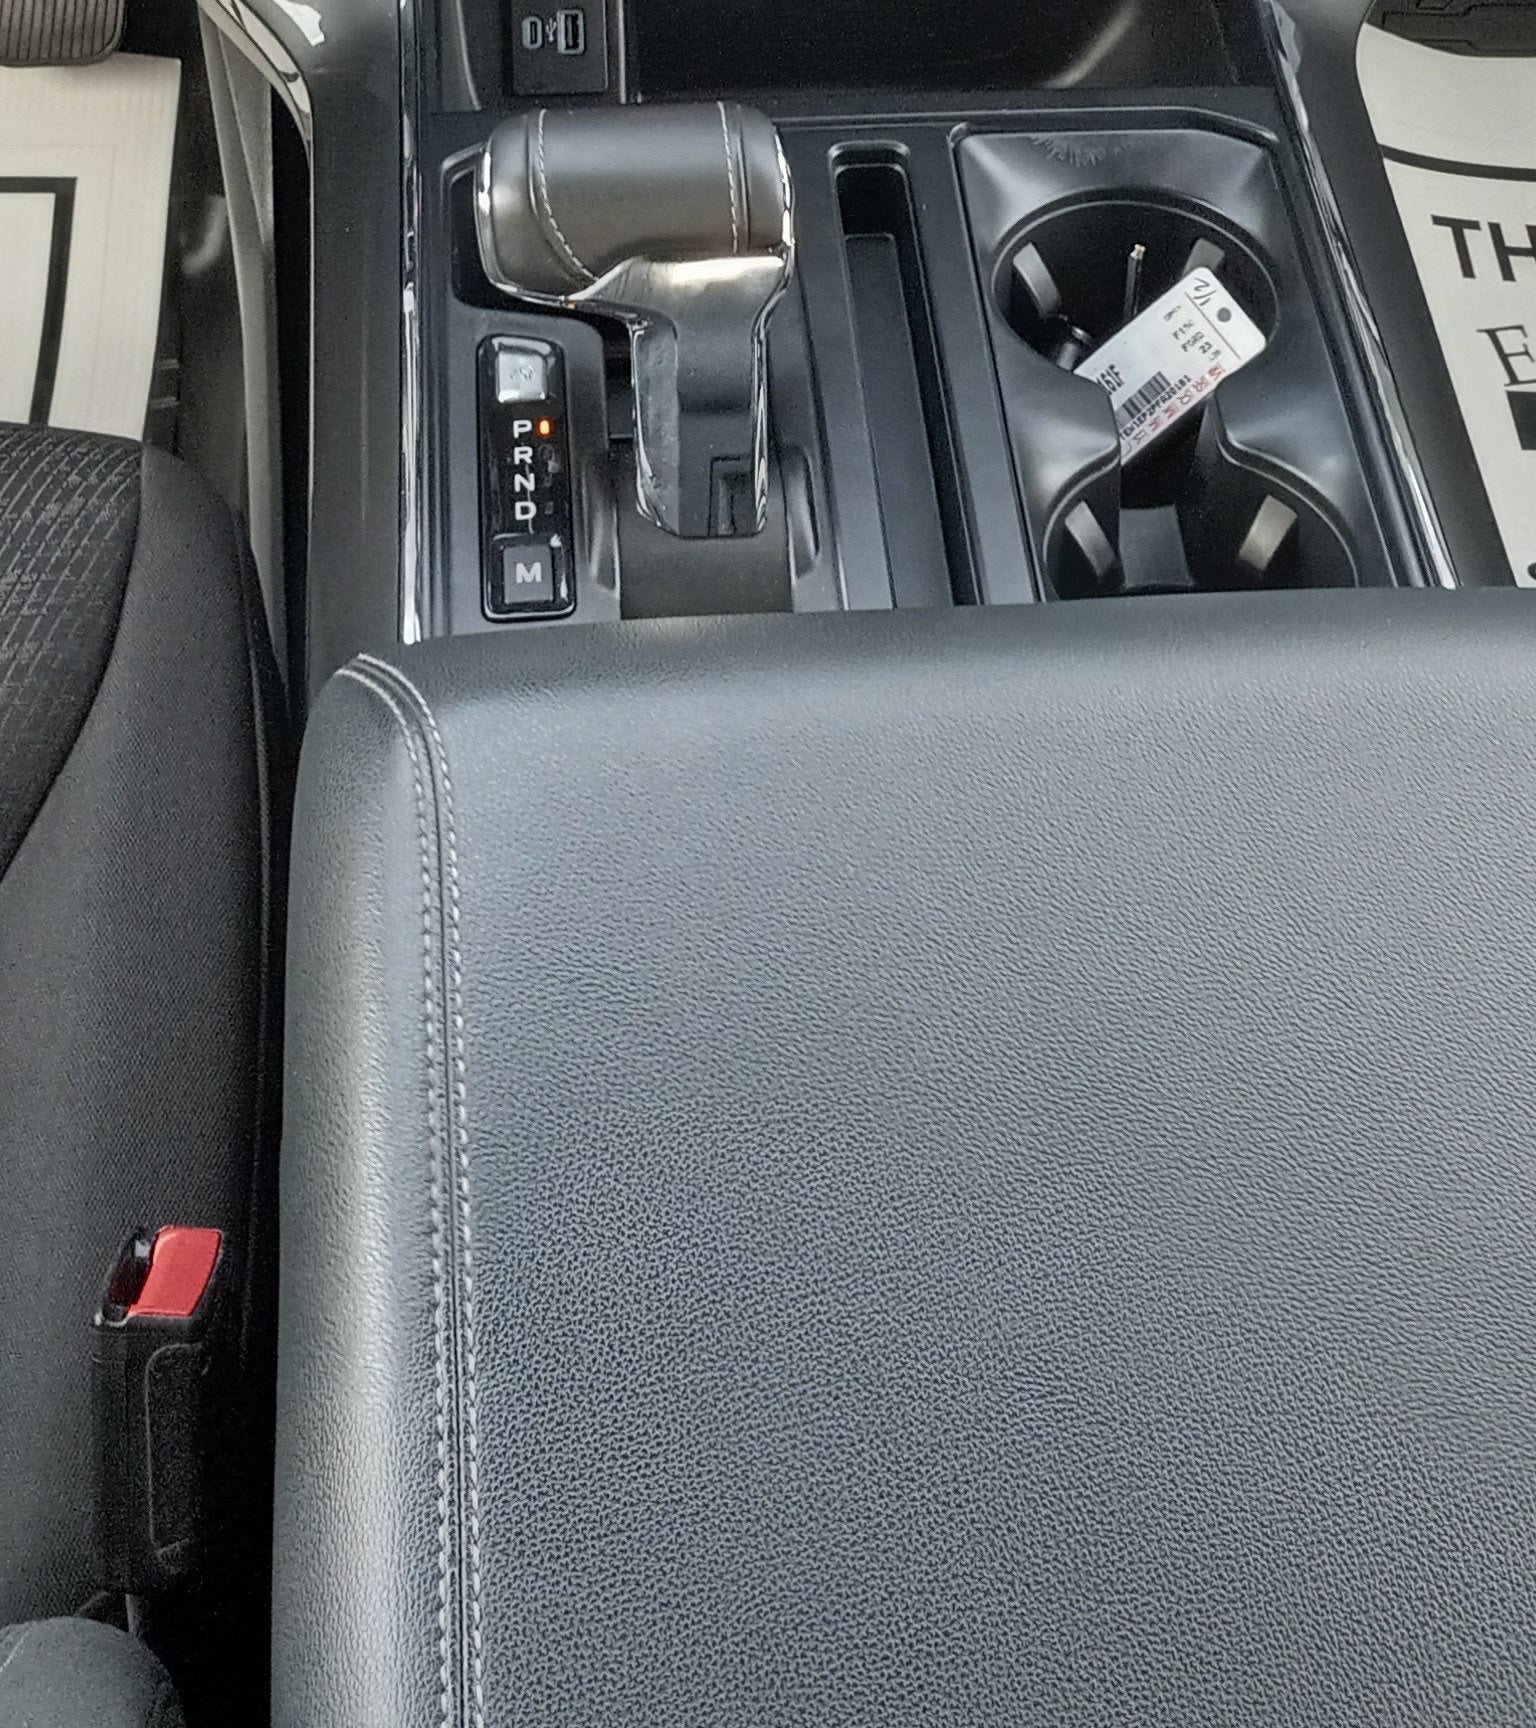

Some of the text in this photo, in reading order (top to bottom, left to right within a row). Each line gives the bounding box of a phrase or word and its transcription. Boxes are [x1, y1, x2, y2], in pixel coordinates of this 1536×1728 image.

[512, 419, 533, 439] P
[513, 445, 534, 465] R
[513, 472, 536, 493] N
[514, 501, 537, 521] D
[515, 561, 543, 585] M
